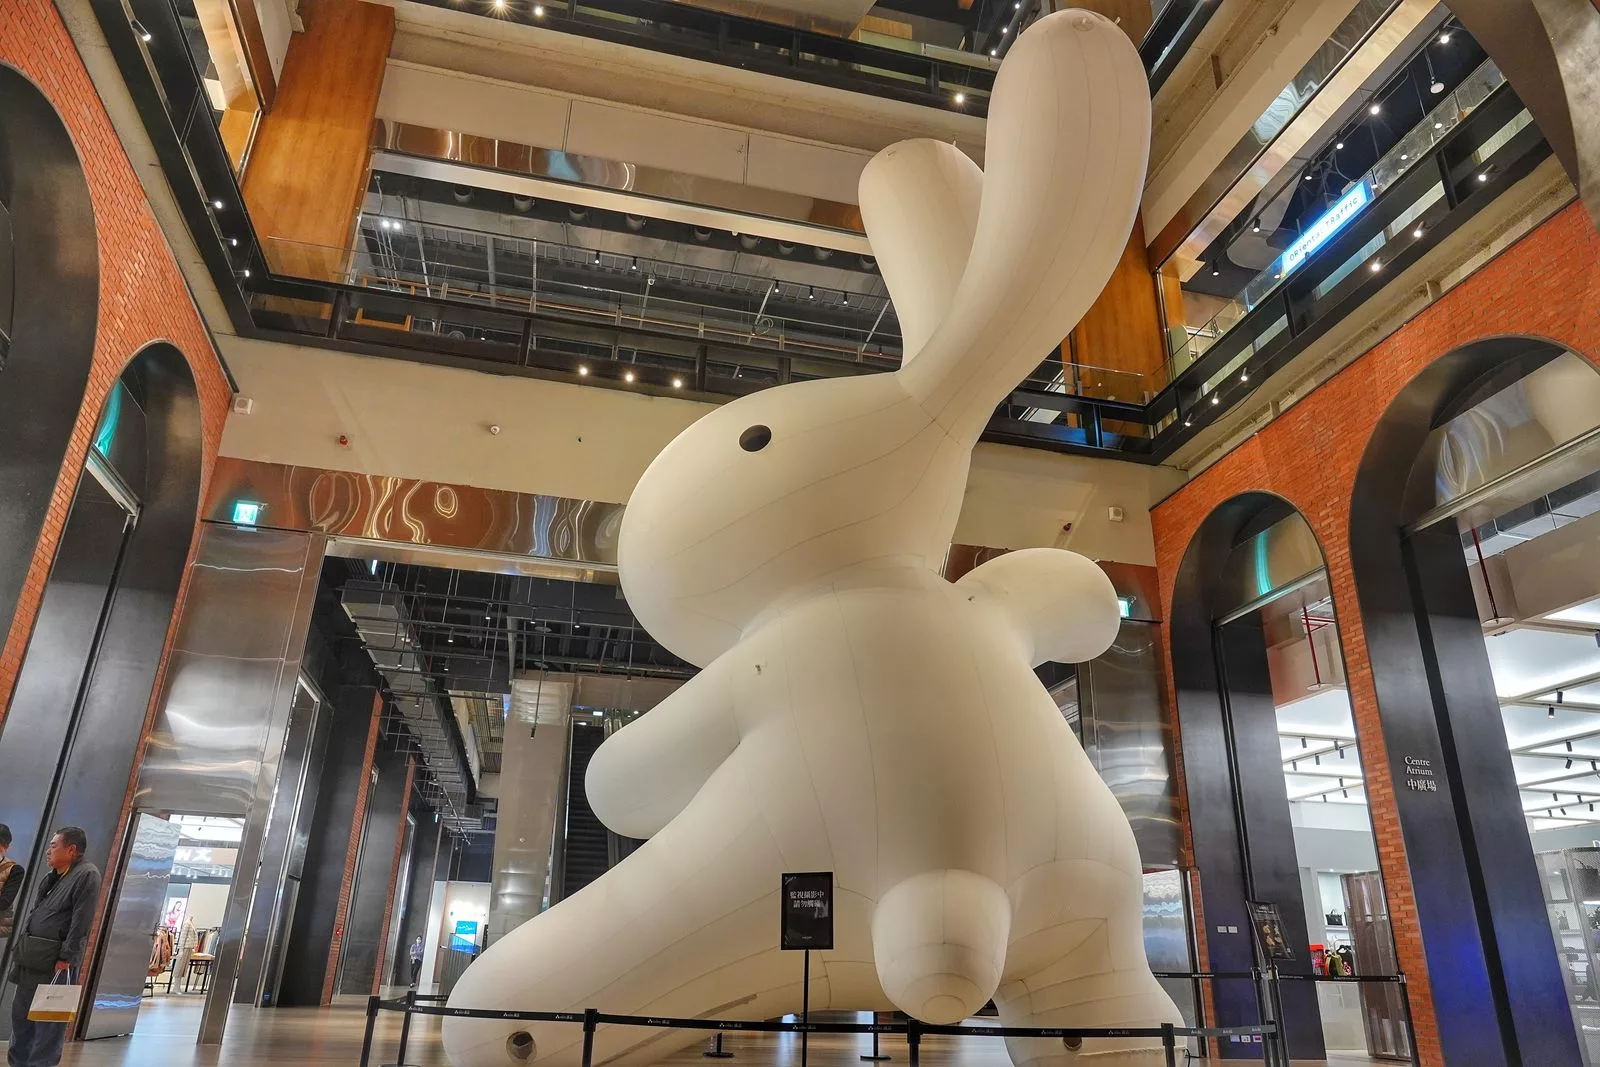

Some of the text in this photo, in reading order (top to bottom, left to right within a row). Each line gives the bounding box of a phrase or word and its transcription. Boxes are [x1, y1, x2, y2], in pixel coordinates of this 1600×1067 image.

[1325, 197, 1358, 226] TRaffic
[1404, 755, 1430, 766] Centre
[1406, 765, 1433, 776] Atrium
[1407, 778, 1437, 792] 中廣場
